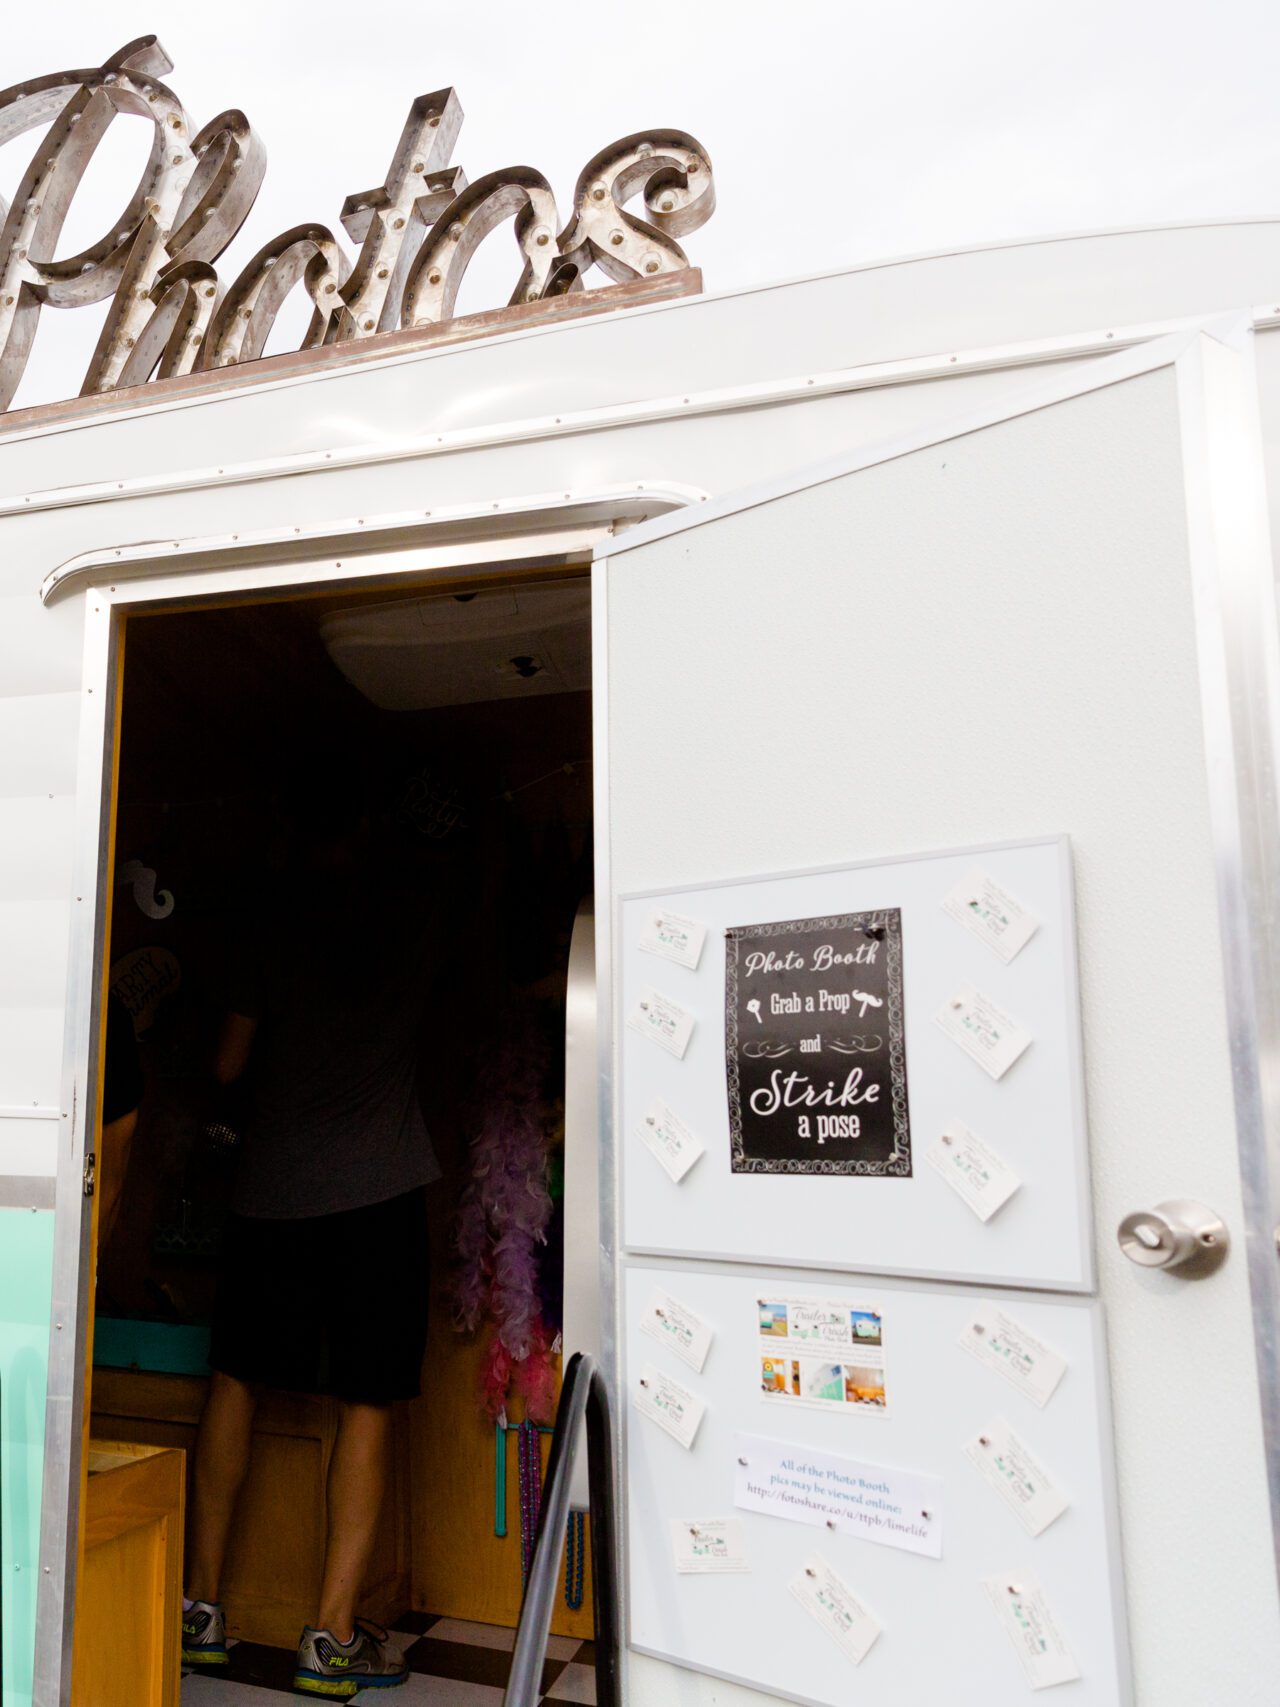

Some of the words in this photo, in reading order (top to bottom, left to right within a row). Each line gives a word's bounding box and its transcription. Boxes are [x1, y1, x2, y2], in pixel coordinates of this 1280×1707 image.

[745, 951, 804, 977] Photo
[810, 941, 880, 972] Booth
[770, 992, 802, 1015] Grab
[804, 999, 815, 1013] a
[818, 989, 851, 1015] Prop
[799, 1034, 822, 1053] and
[749, 1067, 881, 1116] Strike
[797, 1116, 811, 1138] a
[817, 1114, 861, 1144] pose
[780, 1459, 795, 1471] All
[796, 1463, 808, 1474] of
[808, 1464, 824, 1478] the
[826, 1470, 857, 1486] Photo
[858, 1474, 890, 1495] Booth
[770, 1473, 790, 1486] pics
[791, 1480, 812, 1494] may
[813, 1482, 826, 1495] be
[828, 1487, 863, 1505] viewed
[865, 1495, 902, 1515] online:
[329, 1656, 350, 1667] FILA
